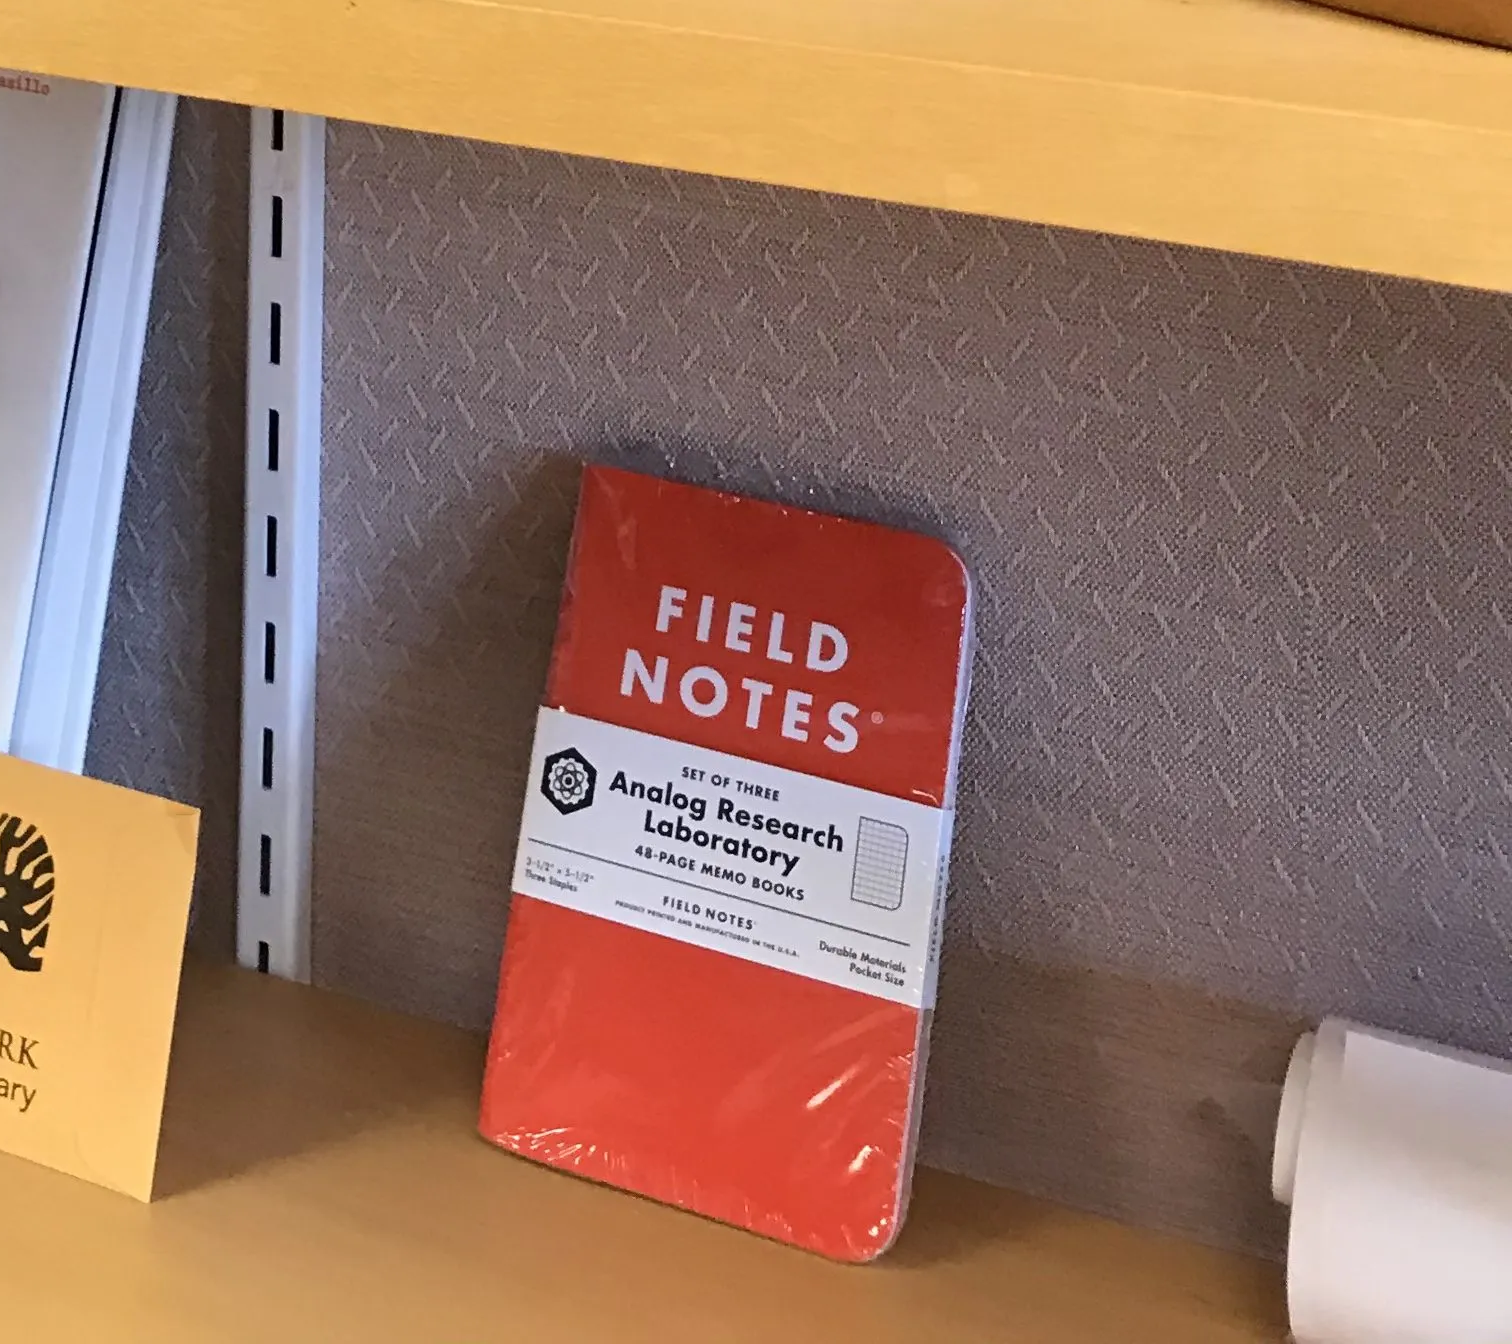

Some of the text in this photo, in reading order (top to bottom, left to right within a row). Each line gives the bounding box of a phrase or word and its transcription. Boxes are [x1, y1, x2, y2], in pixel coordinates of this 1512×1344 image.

[654, 584, 850, 673] FIELD
[681, 766, 780, 802] SET OF THREE
[608, 770, 844, 853] Analog Research
[643, 809, 801, 877] Laboratory
[524, 868, 579, 893] Three Staples
[634, 845, 805, 902] 48-PAGE MEMO BOOKS
[662, 895, 754, 931] FIELD NOTES
[818, 940, 907, 974] Durable Materials
[848, 961, 905, 988] Pocket Size
